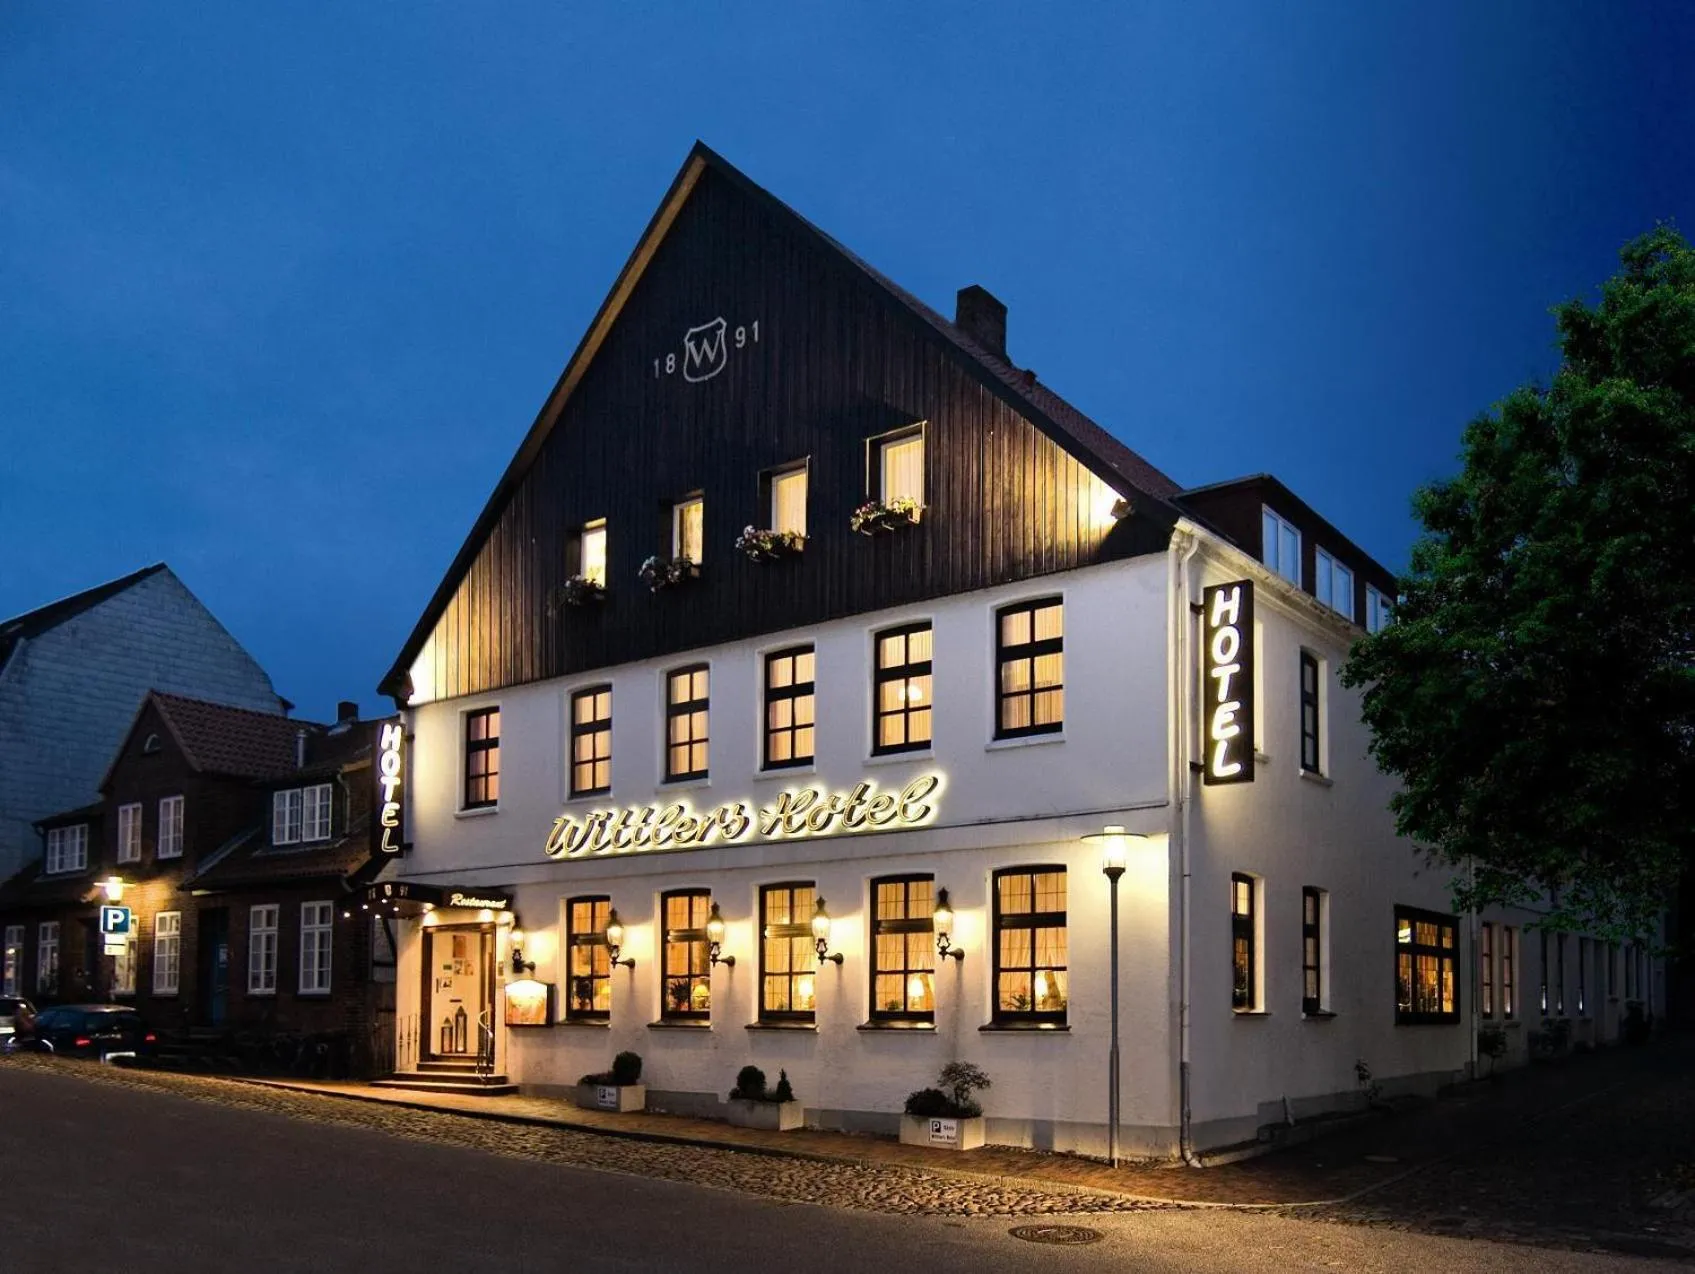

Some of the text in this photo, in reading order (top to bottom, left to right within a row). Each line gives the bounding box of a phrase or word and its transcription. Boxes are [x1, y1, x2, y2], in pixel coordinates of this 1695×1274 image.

[653, 320, 759, 379] 18 W 91
[1210, 586, 1241, 777] HOTEL
[380, 723, 401, 852] HOTEL
[759, 775, 938, 835] Hotel
[107, 909, 125, 930] P
